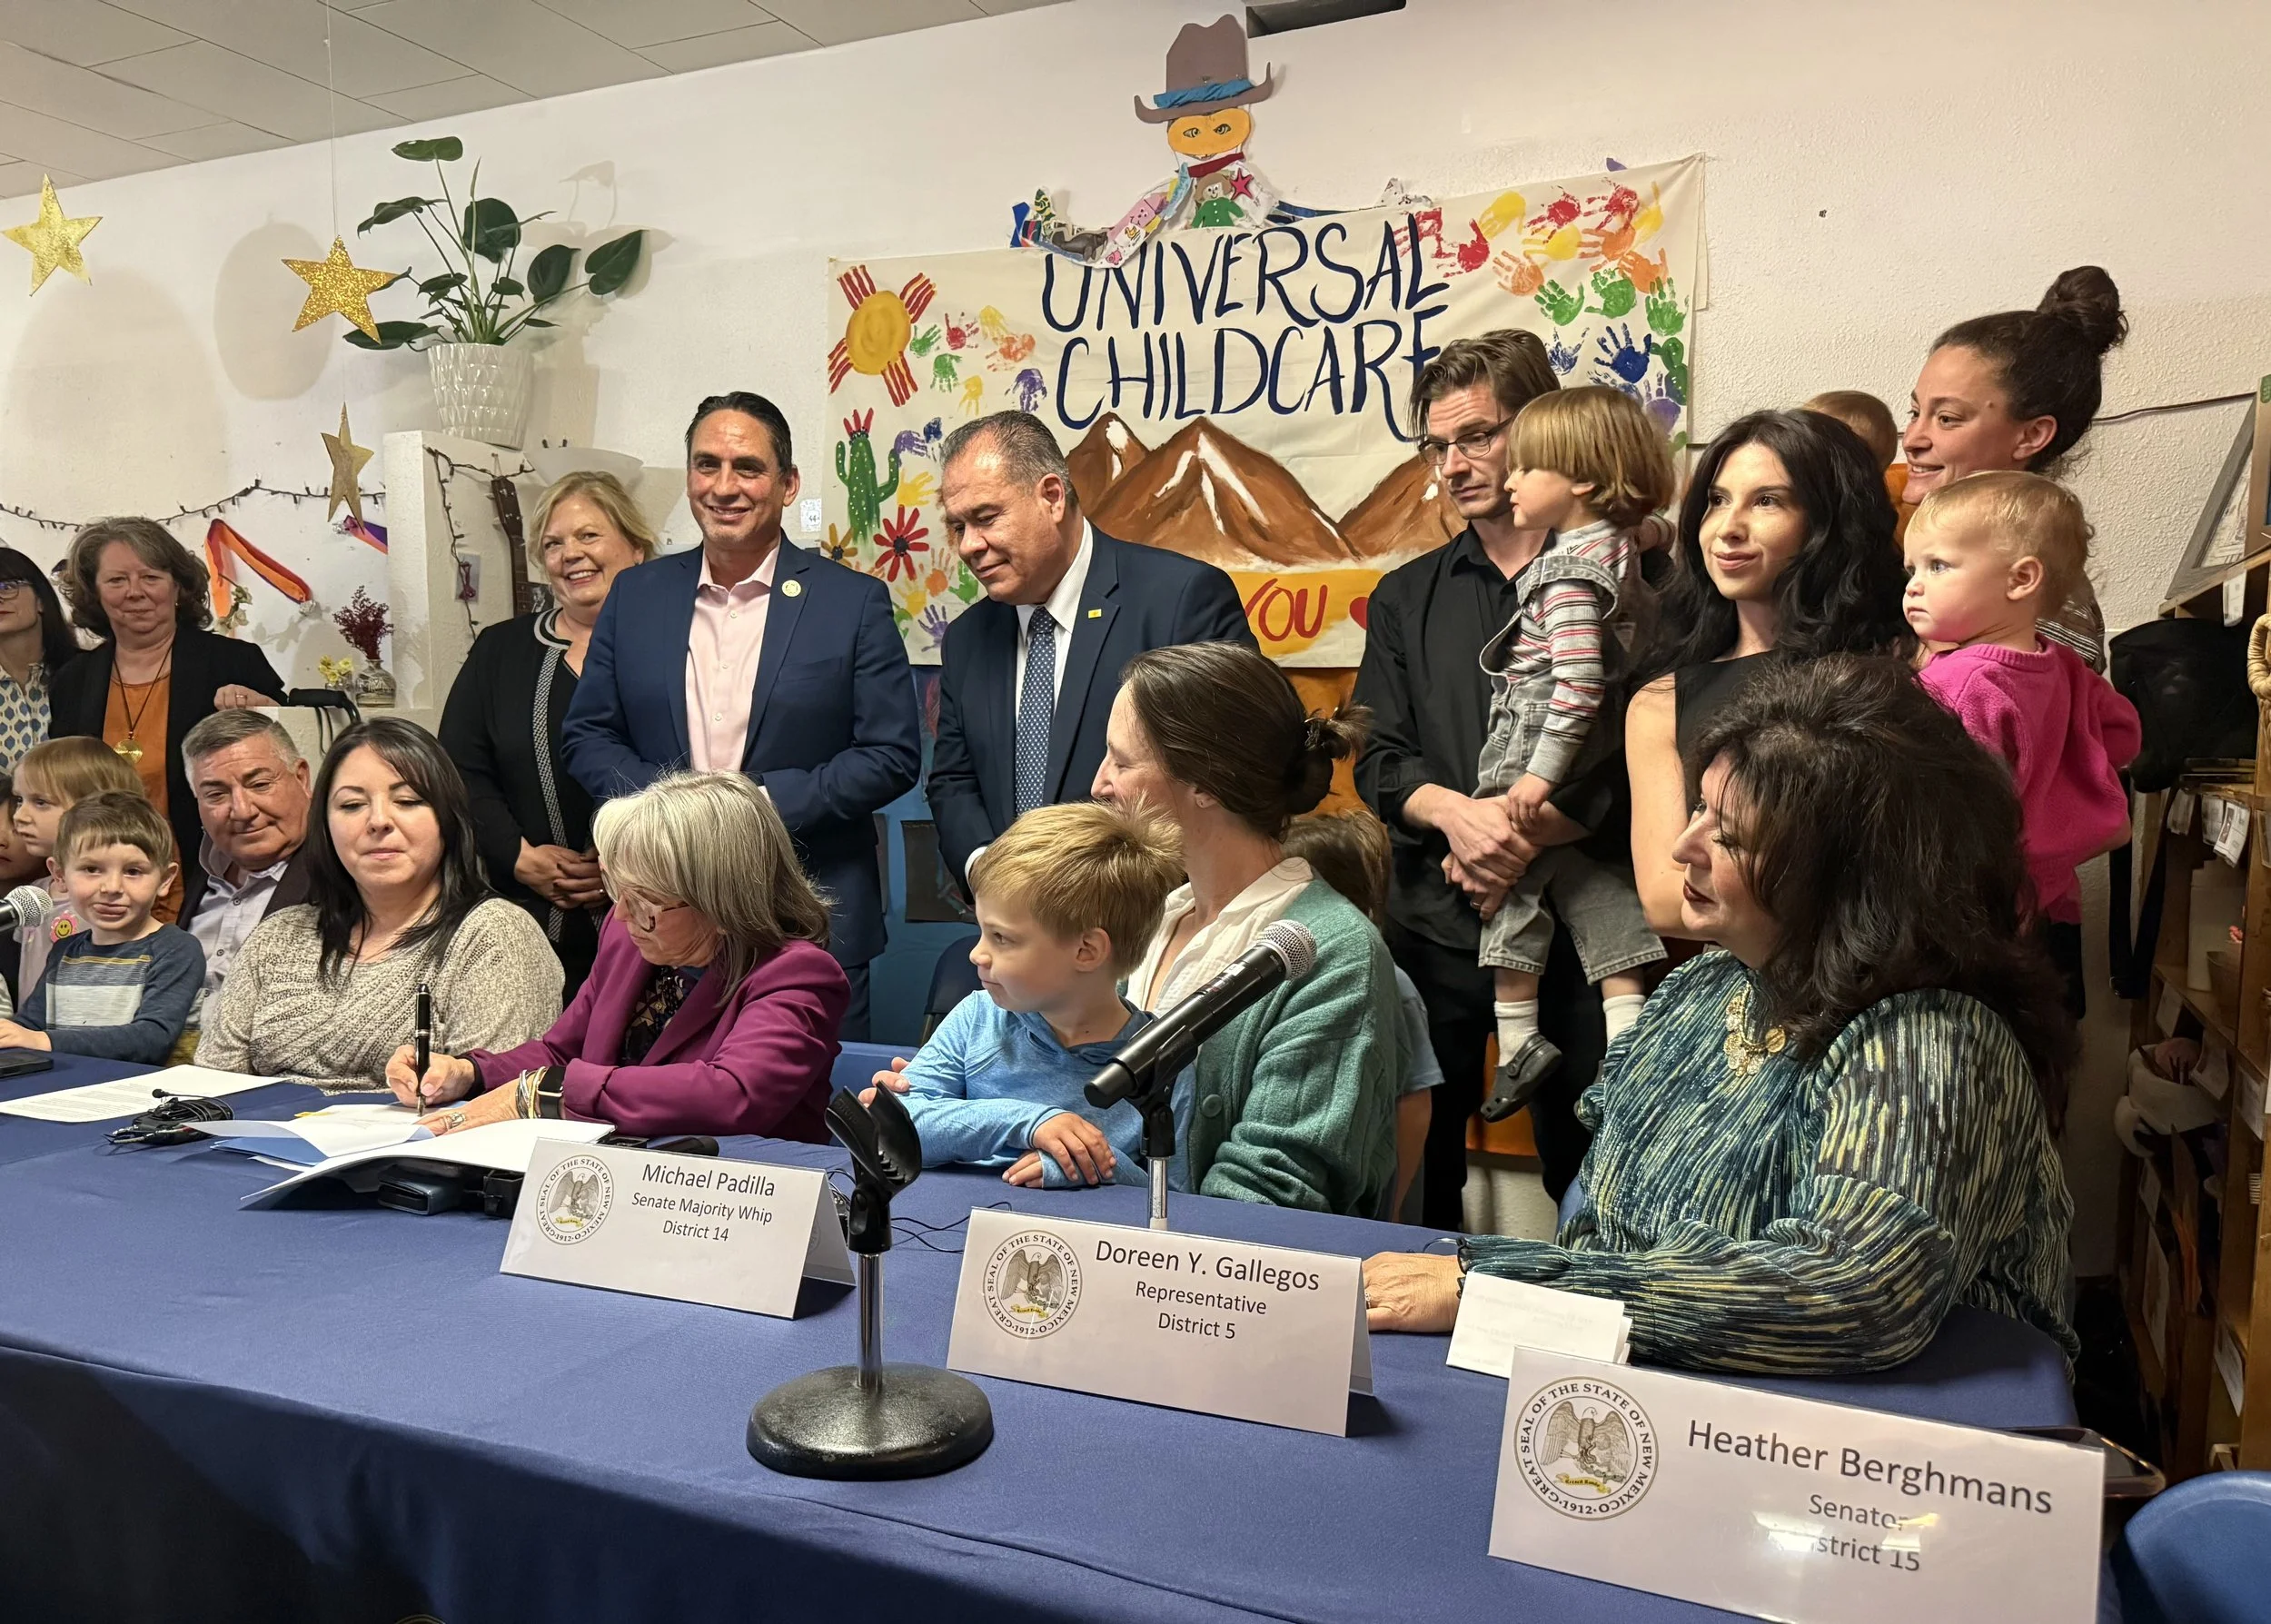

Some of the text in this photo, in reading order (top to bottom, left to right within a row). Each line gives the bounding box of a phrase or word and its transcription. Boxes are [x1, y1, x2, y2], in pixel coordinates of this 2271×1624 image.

[1041, 213, 1450, 332] UNIVERSAL
[550, 1170, 560, 1181] OF
[560, 1159, 579, 1171] THE
[580, 1159, 603, 1173] STATE
[601, 1173, 610, 1183] OF
[641, 1164, 775, 1197] Michael Padilla
[540, 1184, 550, 1206] SEAL
[631, 1192, 773, 1226] Senate Majority Whip
[574, 1212, 605, 1239] MEXICO
[662, 1220, 729, 1242] District 14
[1096, 1240, 1320, 1292] Doreen Y. Gallegos
[987, 1235, 1078, 1332] GREAT SEAL OF THE STATE OF NEW MEXICO
[1136, 1280, 1267, 1315] Representative
[1158, 1312, 1236, 1340] District 5
[1521, 1383, 1652, 1513] GREAT SEAL OF THE STATE OF NEW MEXICO
[1688, 1419, 2053, 1515] Heather Berghmans
[1810, 1535, 1920, 1572] strict 15
